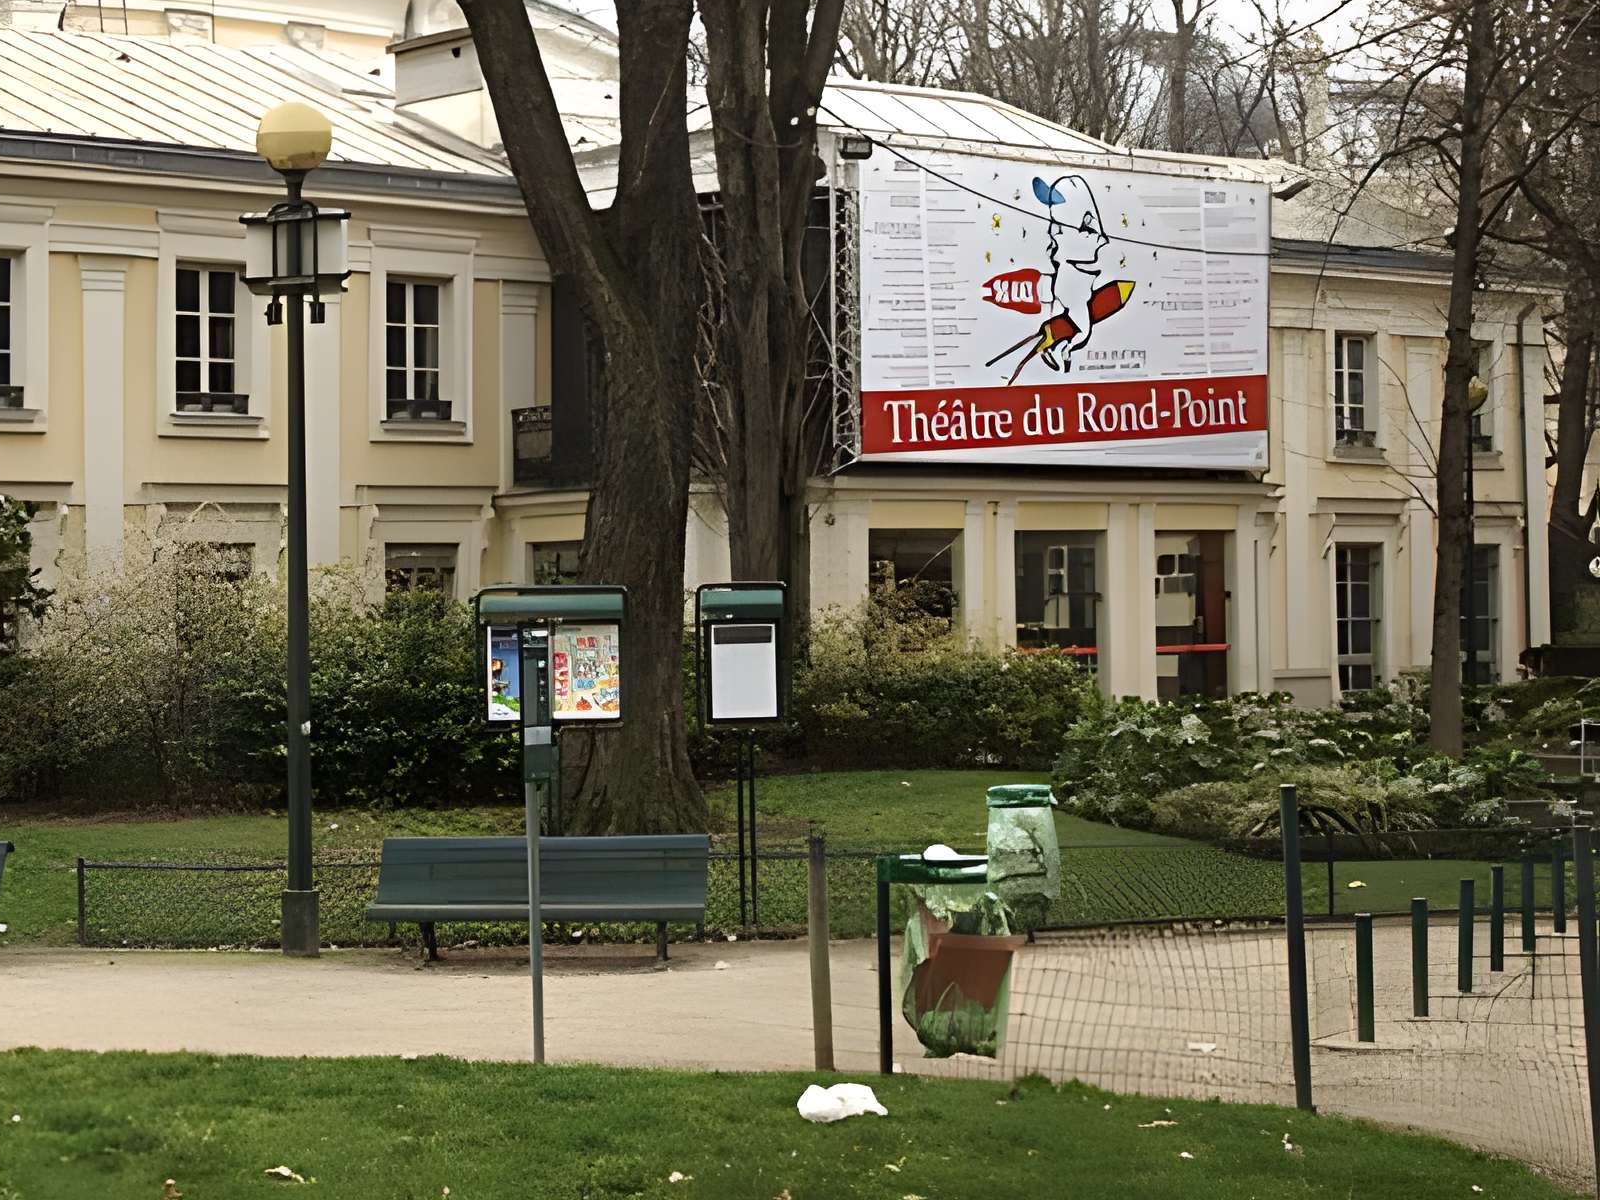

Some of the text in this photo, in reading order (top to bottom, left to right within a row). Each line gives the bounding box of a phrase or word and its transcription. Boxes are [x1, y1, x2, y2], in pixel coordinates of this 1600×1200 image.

[883, 387, 1248, 444] Théâtre du Rond-Point
